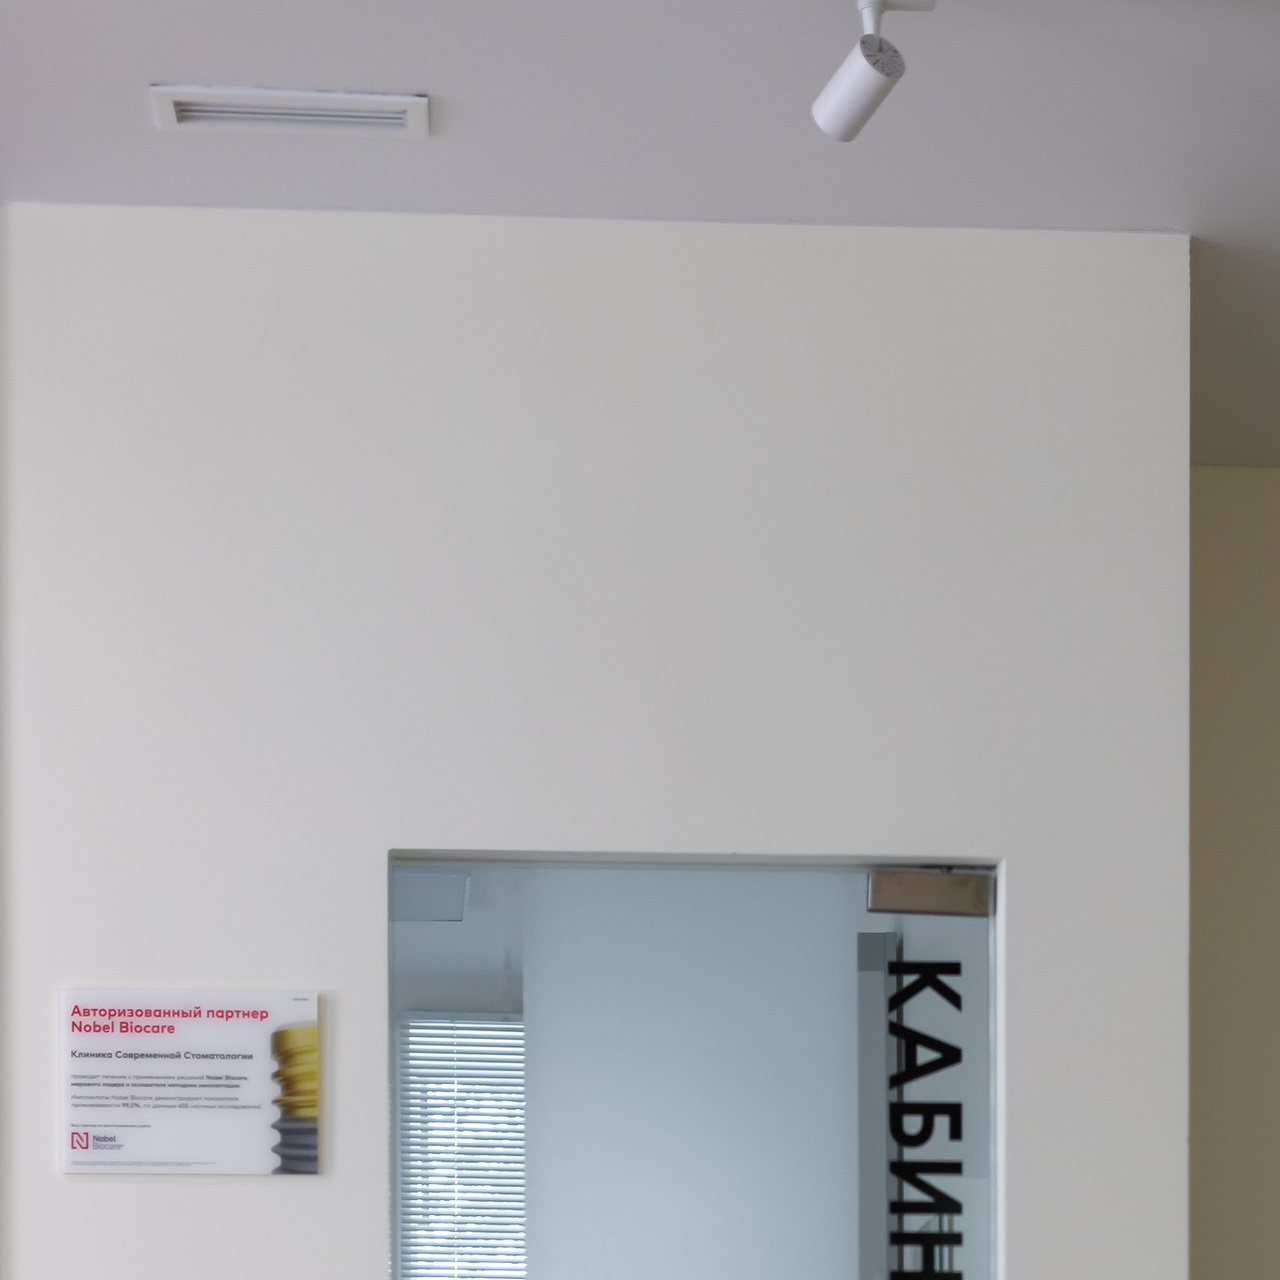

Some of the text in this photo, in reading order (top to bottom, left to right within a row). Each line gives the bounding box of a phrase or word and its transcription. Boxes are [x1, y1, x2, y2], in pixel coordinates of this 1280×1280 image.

[71, 1005, 269, 1021] Авторизованный партнер
[71, 1021, 175, 1034] Nobel Biocare
[71, 1051, 253, 1061] Клиника Современной Стоматологии
